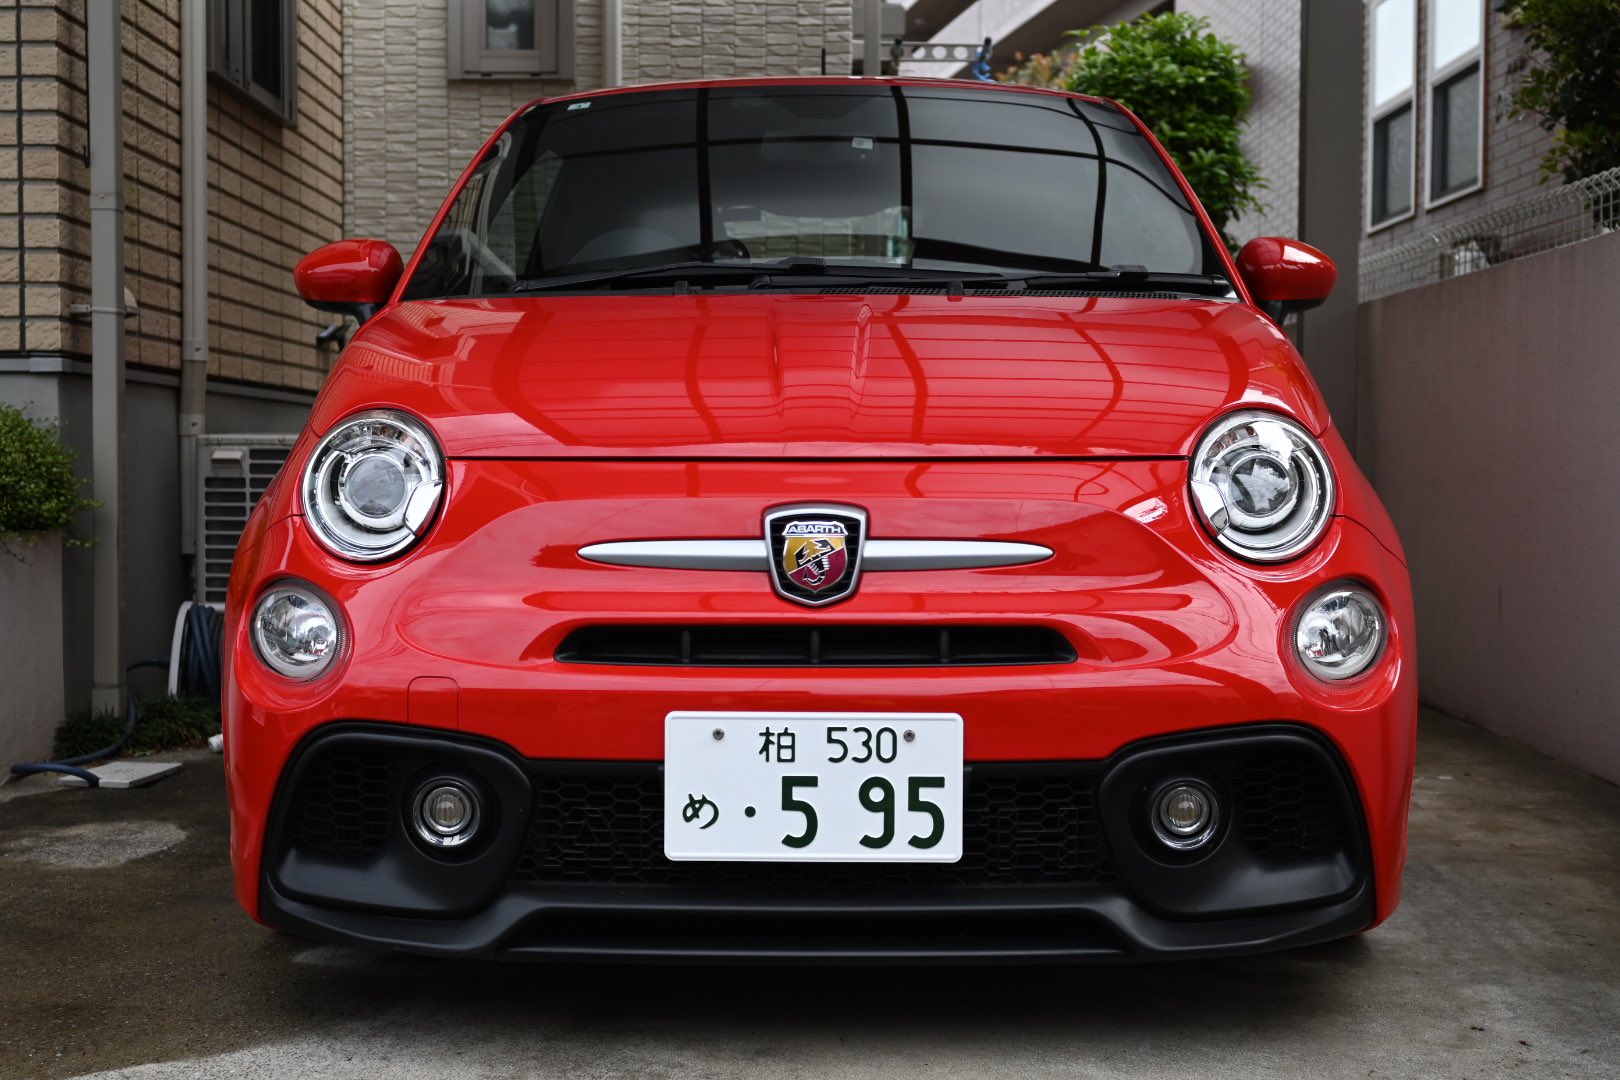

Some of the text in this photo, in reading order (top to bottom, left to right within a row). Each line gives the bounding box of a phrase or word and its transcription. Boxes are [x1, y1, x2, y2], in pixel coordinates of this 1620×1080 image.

[788, 525, 841, 534] ABARTH
[758, 726, 898, 764] 柏 530
[682, 793, 720, 829] め
[858, 775, 946, 849] 95
